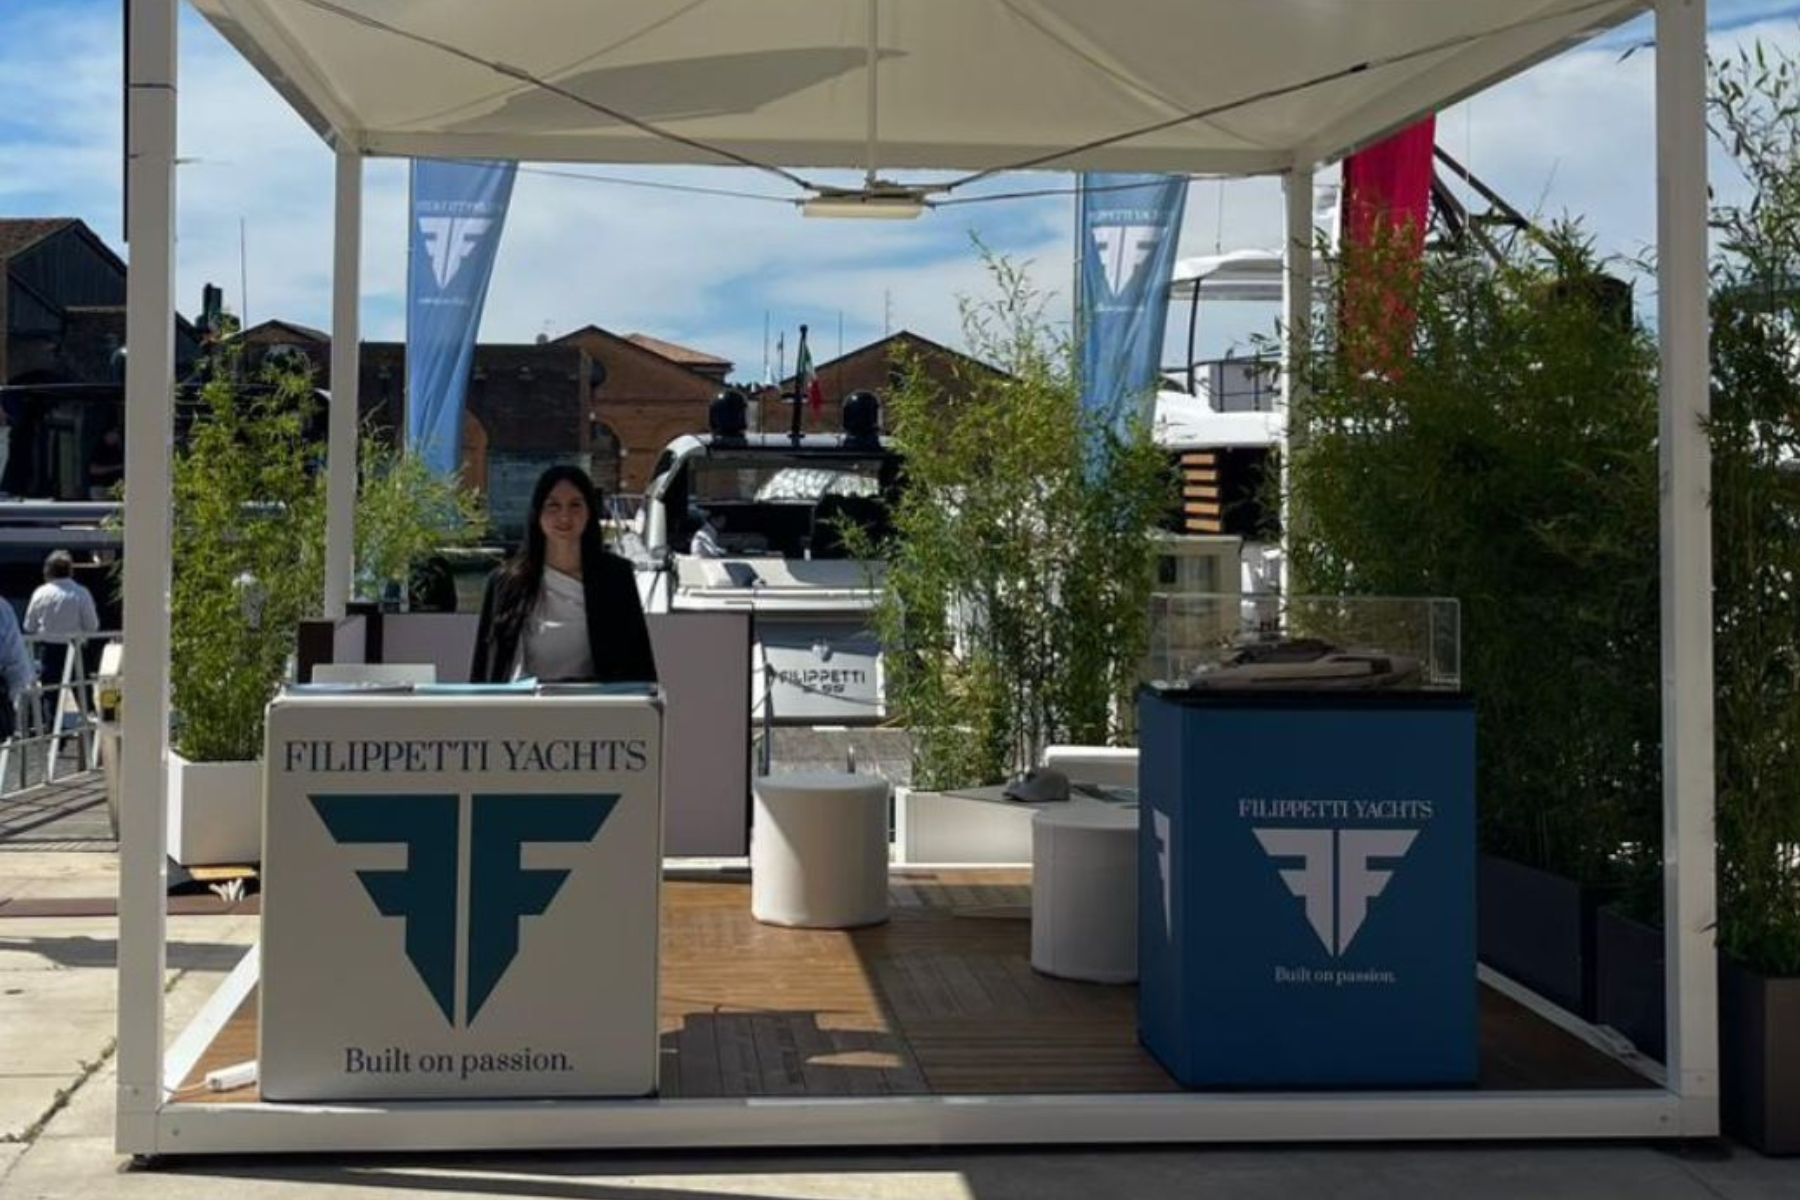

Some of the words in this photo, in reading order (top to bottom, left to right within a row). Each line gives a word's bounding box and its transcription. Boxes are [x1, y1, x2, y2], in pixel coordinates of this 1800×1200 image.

[284, 740, 488, 772] FILIPPETTI
[501, 740, 647, 772] YACHTS
[1238, 799, 1348, 818] FILIPPETTI
[1354, 800, 1433, 819] YACHTS
[1275, 966, 1310, 983] Built
[1314, 970, 1334, 982] on
[345, 1047, 411, 1073] Built
[418, 1055, 454, 1073] on
[461, 1047, 574, 1081] passion.
